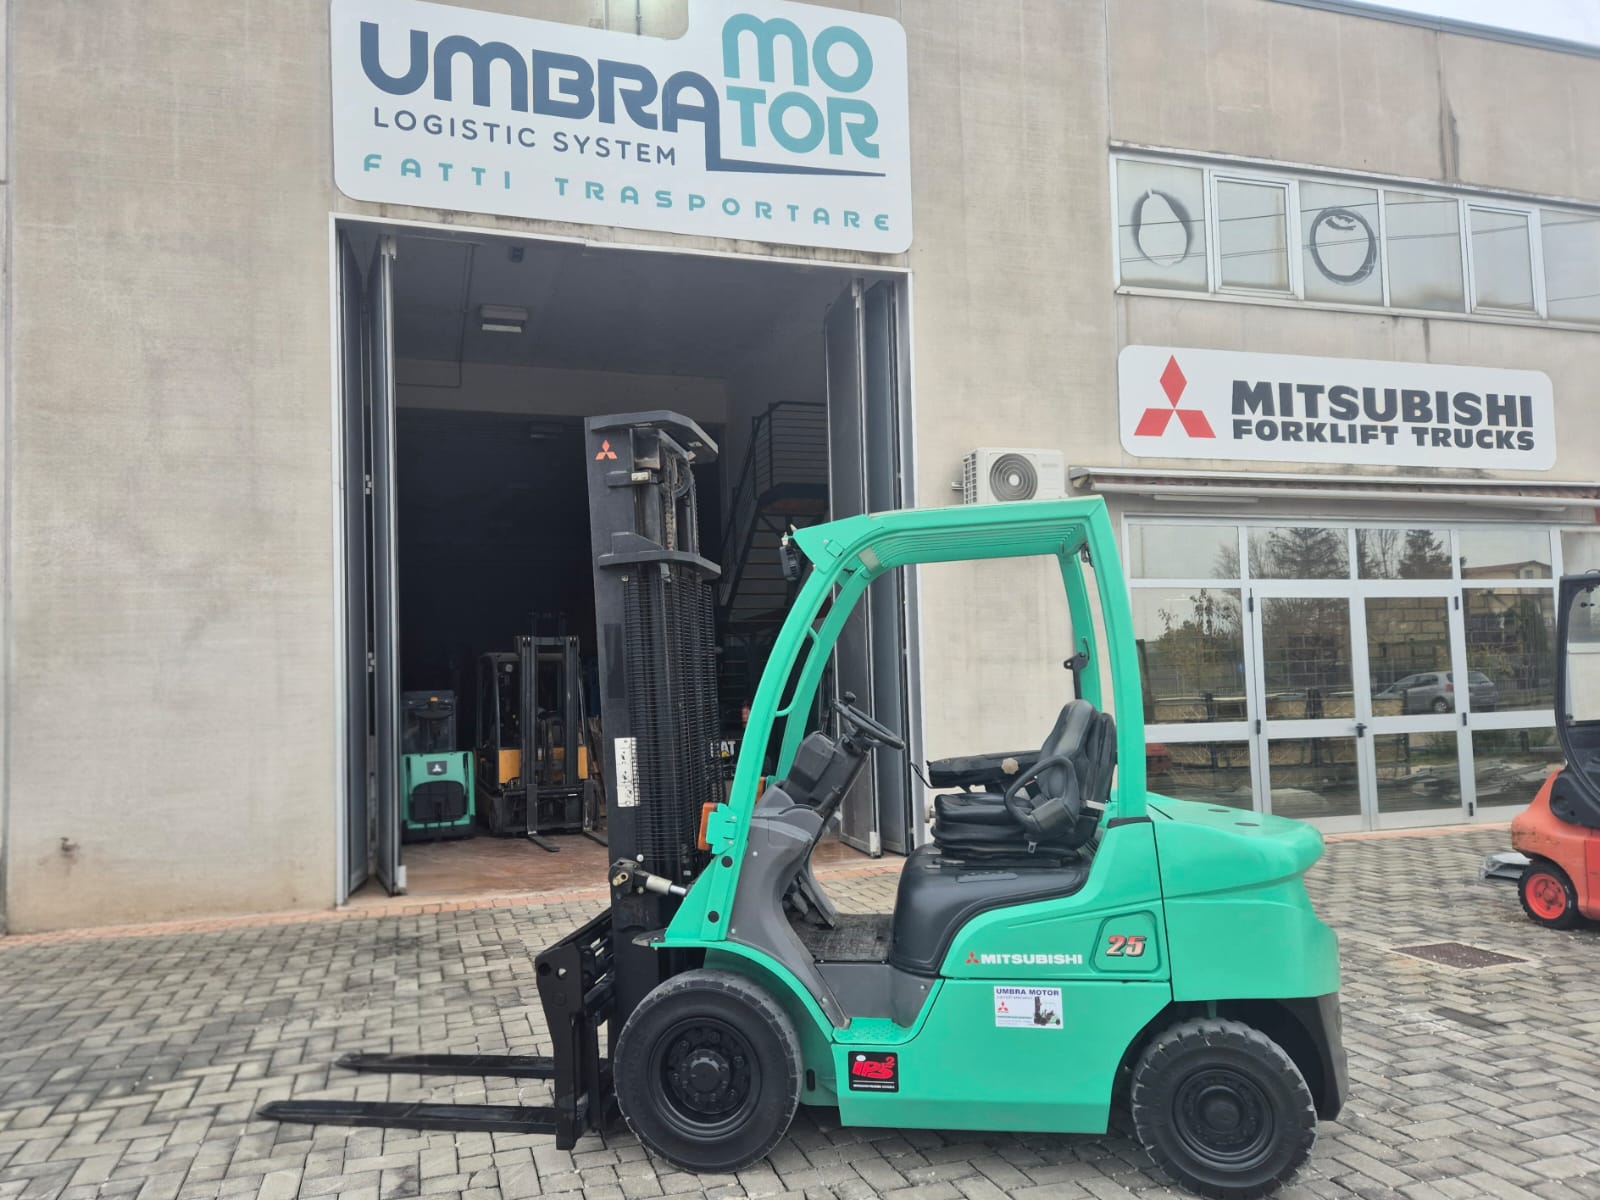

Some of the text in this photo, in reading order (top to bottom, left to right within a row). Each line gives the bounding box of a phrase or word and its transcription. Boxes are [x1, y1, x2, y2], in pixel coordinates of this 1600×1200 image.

[360, 21, 720, 135] UMBRA
[722, 13, 873, 93] MO
[374, 107, 676, 166] LOGISTIC SYSTEM
[727, 86, 879, 159] TOR
[364, 153, 889, 232] FATTI TRASPORTARE
[1232, 380, 1534, 428] MITSUBISHI
[1233, 419, 1535, 452] FORKLIFT TRUCKS
[981, 953, 1083, 965] MITSUBISHI
[1106, 935, 1146, 957] 25
